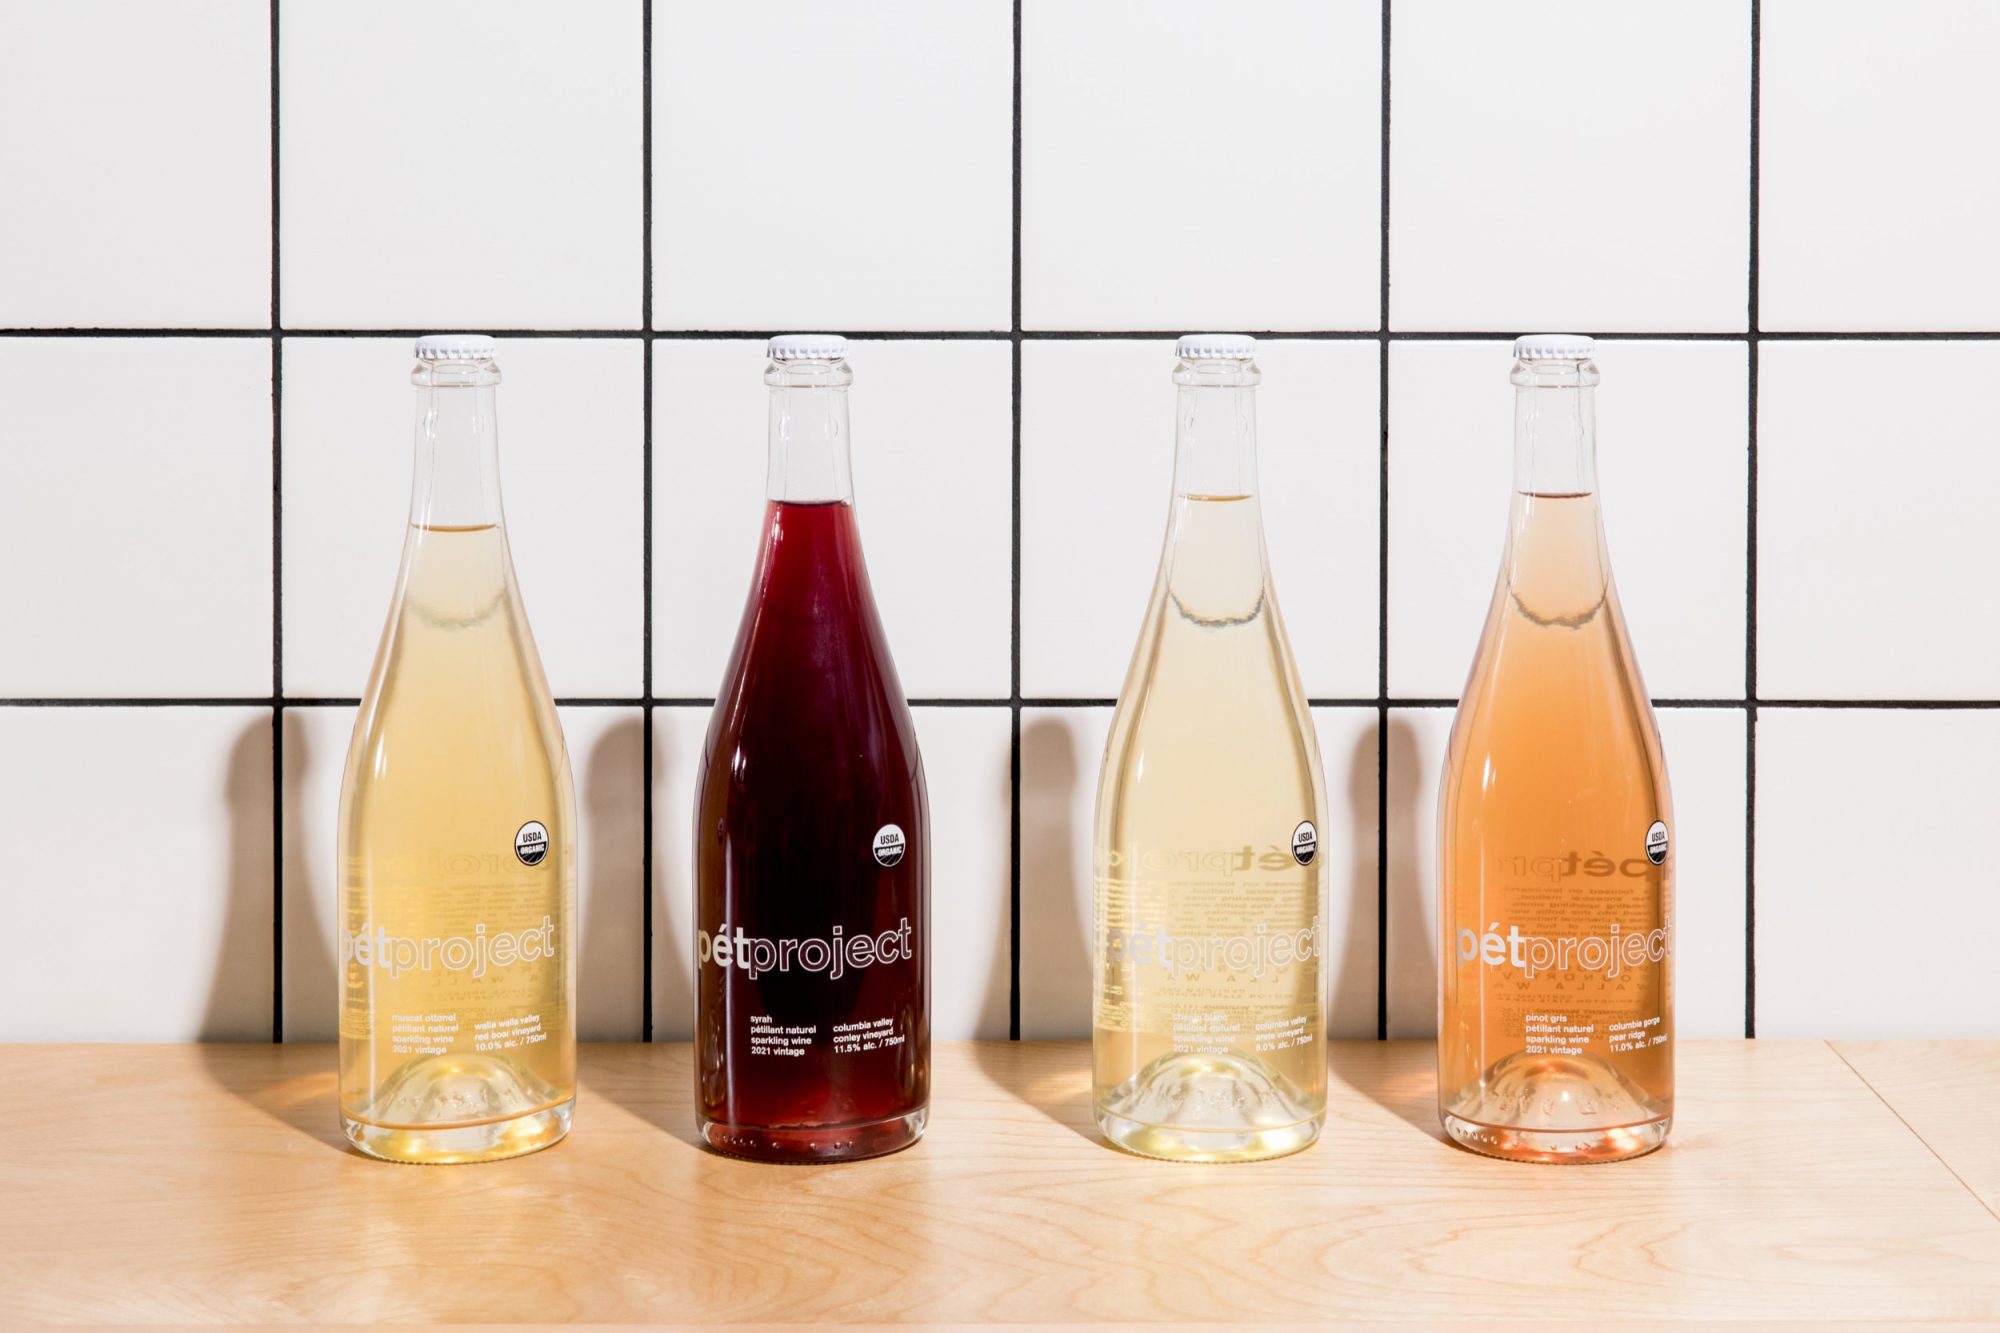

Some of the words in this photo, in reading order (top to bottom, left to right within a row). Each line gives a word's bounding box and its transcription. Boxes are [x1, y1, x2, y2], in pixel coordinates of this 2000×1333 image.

[523, 831, 542, 843] USDA
[880, 833, 900, 845] USDA
[1298, 831, 1313, 843] USDA
[1651, 831, 1665, 843] USDA
[520, 843, 545, 855] ORGANIC
[877, 845, 902, 857] ORGANIC
[697, 917, 912, 980] pétproject
[474, 1021, 496, 1030] walla
[520, 1014, 540, 1025] valley
[750, 1014, 773, 1024] syrah
[833, 1020, 871, 1032] columbia
[873, 1017, 893, 1027] valley
[1525, 1013, 1548, 1022] pinot
[1550, 1014, 1568, 1024] gris
[1609, 1020, 1642, 1031] columbia
[1643, 1016, 1660, 1028] gorge
[428, 1023, 459, 1032] naturel
[475, 1031, 489, 1040] red
[511, 1022, 541, 1036] vineyard
[750, 1025, 784, 1035] pétillant
[785, 1025, 817, 1034] naturel
[1525, 1024, 1561, 1033] pétillant
[1563, 1024, 1594, 1033] naturel
[432, 1035, 454, 1043] wine
[833, 1033, 861, 1043] conley
[862, 1026, 894, 1040] vineyard
[1525, 1035, 1567, 1045] sparkling
[1568, 1035, 1590, 1044] wine
[1609, 1033, 1627, 1042] pear
[1628, 1030, 1645, 1040] ridge
[475, 1041, 502, 1051] 10.0%
[504, 1038, 518, 1048] alc.
[519, 1037, 524, 1046] /
[526, 1031, 547, 1044] 750ml
[751, 1036, 789, 1046] sparkling
[791, 1036, 812, 1045] wine
[834, 1043, 861, 1053] 11.5%
[863, 1041, 877, 1051] alc.
[878, 1039, 883, 1048] /
[884, 1034, 905, 1046] 750ml
[1609, 1042, 1633, 1052] 11.0%
[392, 1045, 412, 1053] 2021
[415, 1046, 447, 1056] vintage
[751, 1046, 771, 1055] 2021
[773, 1046, 805, 1057] vintage
[1173, 1045, 1194, 1053] 2021
[1196, 1046, 1229, 1055] vintage
[1525, 1045, 1547, 1053] 2021
[1550, 1046, 1583, 1056] vintage
